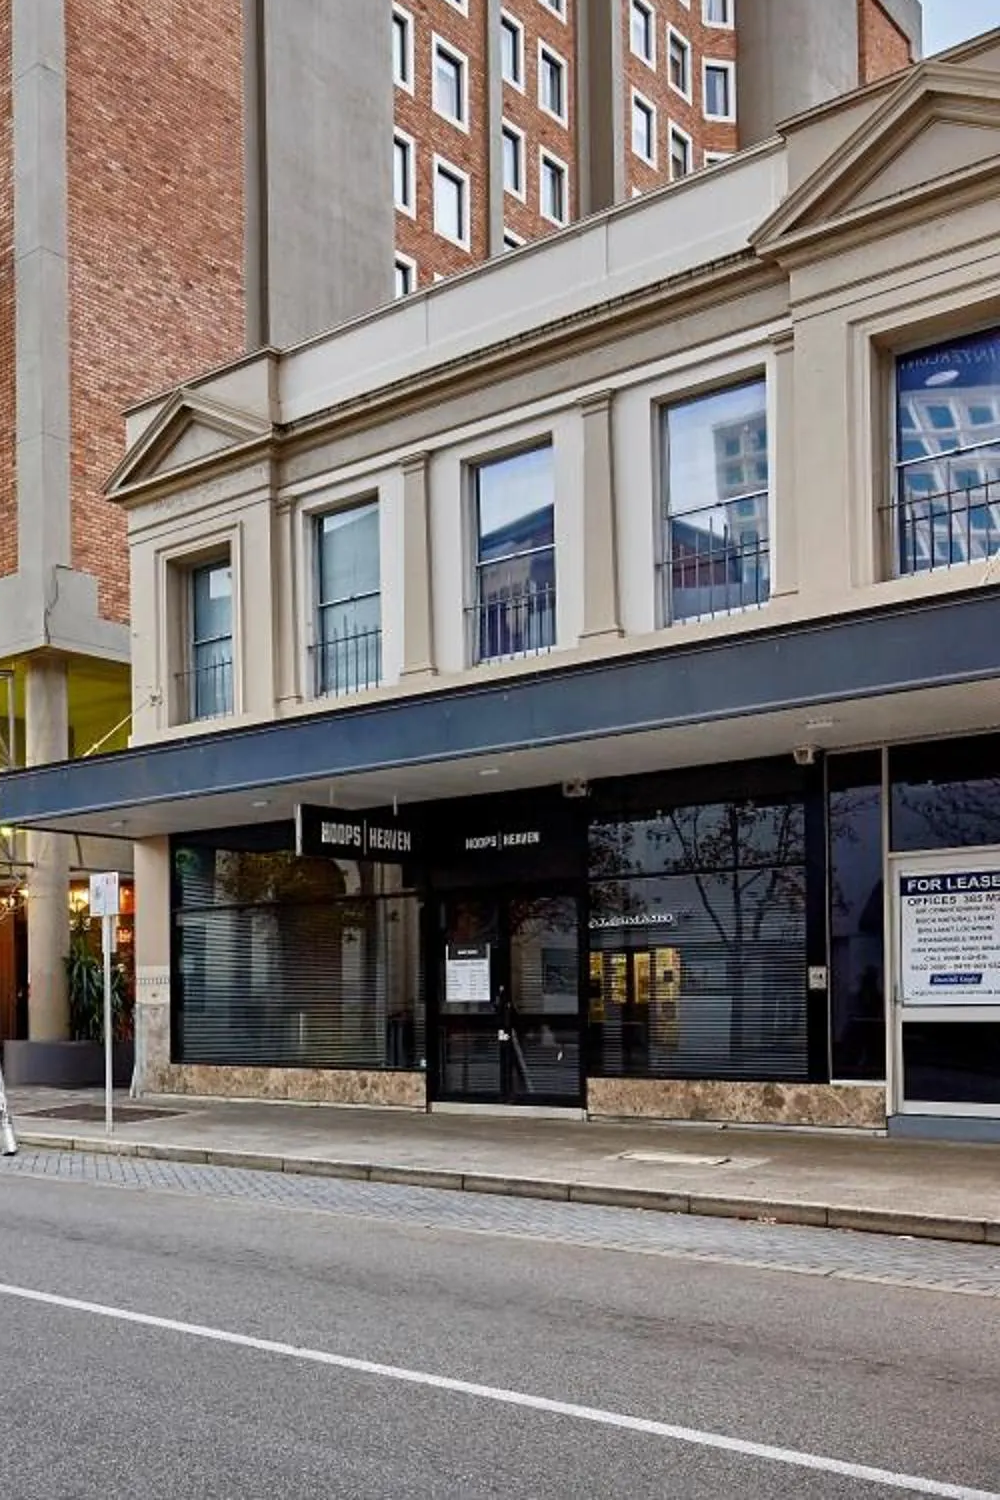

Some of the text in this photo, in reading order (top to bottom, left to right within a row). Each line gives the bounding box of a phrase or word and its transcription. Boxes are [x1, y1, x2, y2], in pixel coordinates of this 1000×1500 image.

[321, 821, 411, 852] HOOPS HEAVEN
[466, 831, 540, 850] HOOPS HEAVEN
[907, 875, 1000, 893] FOR LEASE
[907, 895, 957, 906] OFFICES
